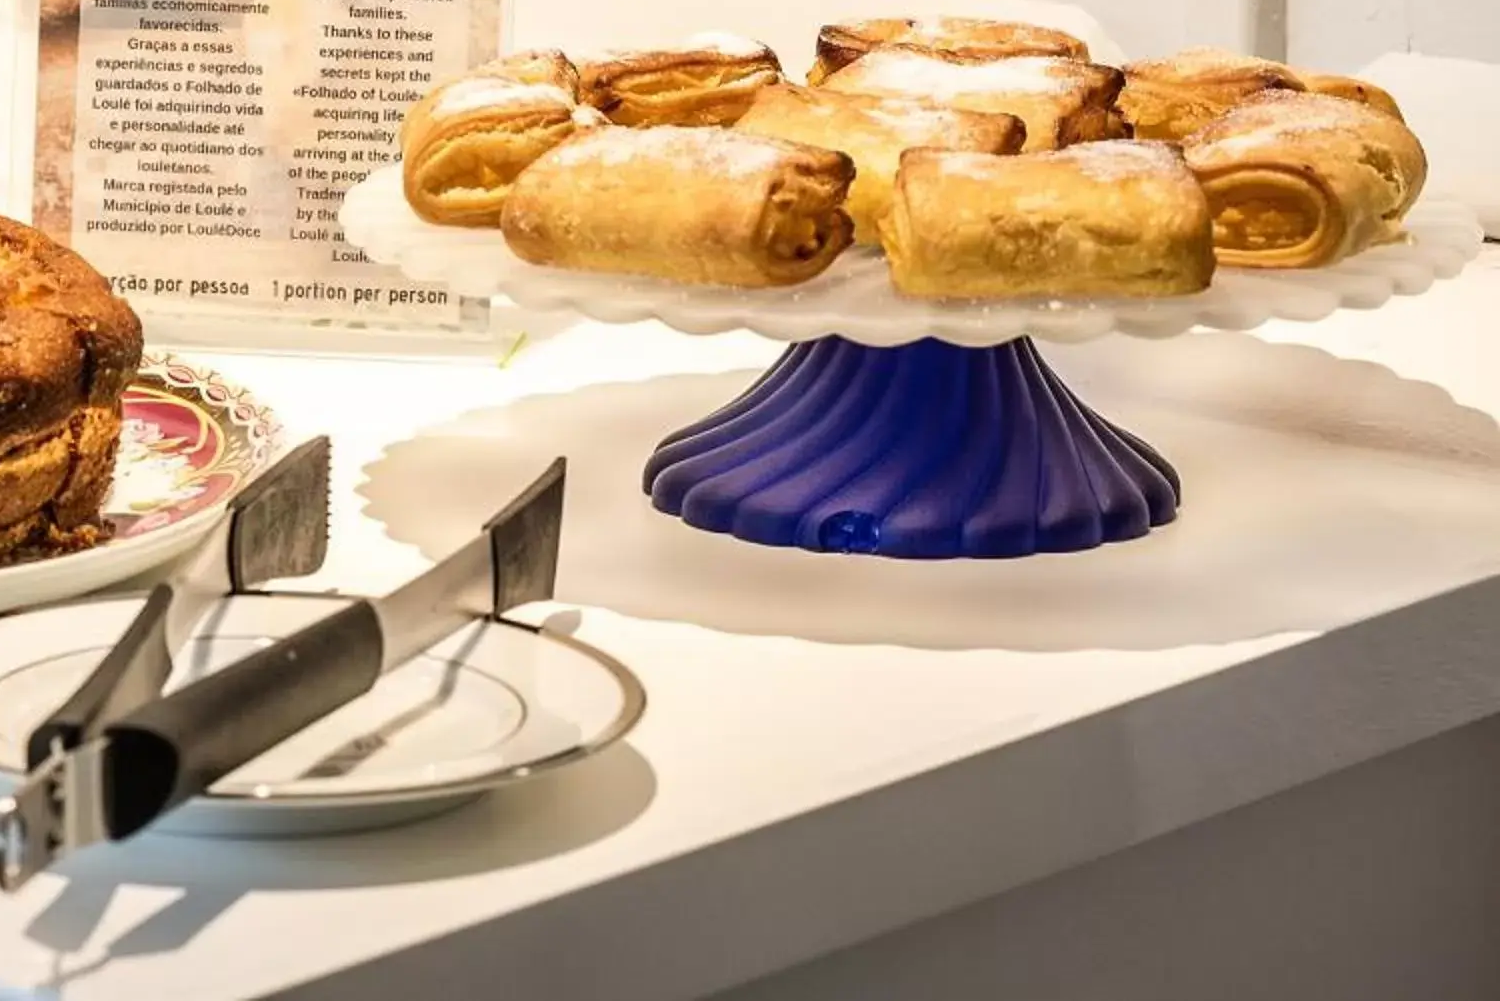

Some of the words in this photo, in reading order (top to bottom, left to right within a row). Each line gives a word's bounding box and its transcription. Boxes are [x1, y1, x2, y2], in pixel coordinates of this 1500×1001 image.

[349, 6, 407, 19] families.
[323, 25, 372, 39] Thanks
[395, 29, 433, 41] these
[128, 38, 176, 53] Graças
[193, 42, 233, 53] essas
[319, 48, 403, 61] experiences
[408, 51, 433, 61] and
[96, 58, 183, 72] experiências
[200, 62, 263, 76] segredos
[320, 67, 370, 79] secrets
[376, 68, 406, 83] kept
[409, 70, 431, 82] the
[95, 78, 168, 91] guardados
[186, 81, 242, 94] Folhado
[92, 97, 130, 110] Loulé
[135, 99, 152, 111] foi
[156, 100, 230, 115] adquirindo
[235, 104, 263, 115] vida
[313, 107, 378, 122] acquiring
[383, 109, 404, 121] life
[122, 120, 220, 134] personalidade
[224, 123, 245, 135] até
[318, 129, 395, 144] personality
[89, 138, 135, 153] chegar
[161, 141, 234, 155] quotidiano
[239, 145, 264, 156] dos
[293, 149, 346, 163] arriving
[368, 150, 389, 162] the
[306, 168, 328, 180] the
[103, 179, 144, 191] Marca
[149, 181, 213, 195] registada
[218, 184, 247, 197] pelo
[195, 202, 233, 215] Loulé
[318, 208, 338, 220] the
[87, 218, 156, 232] produzido
[160, 222, 183, 234] por
[188, 223, 261, 237] LouléDoce
[290, 228, 328, 240] Loulé
[155, 278, 183, 294] por
[190, 281, 249, 296] pessoa
[284, 283, 346, 301] portion
[354, 286, 380, 304] per
[389, 287, 448, 305] person
